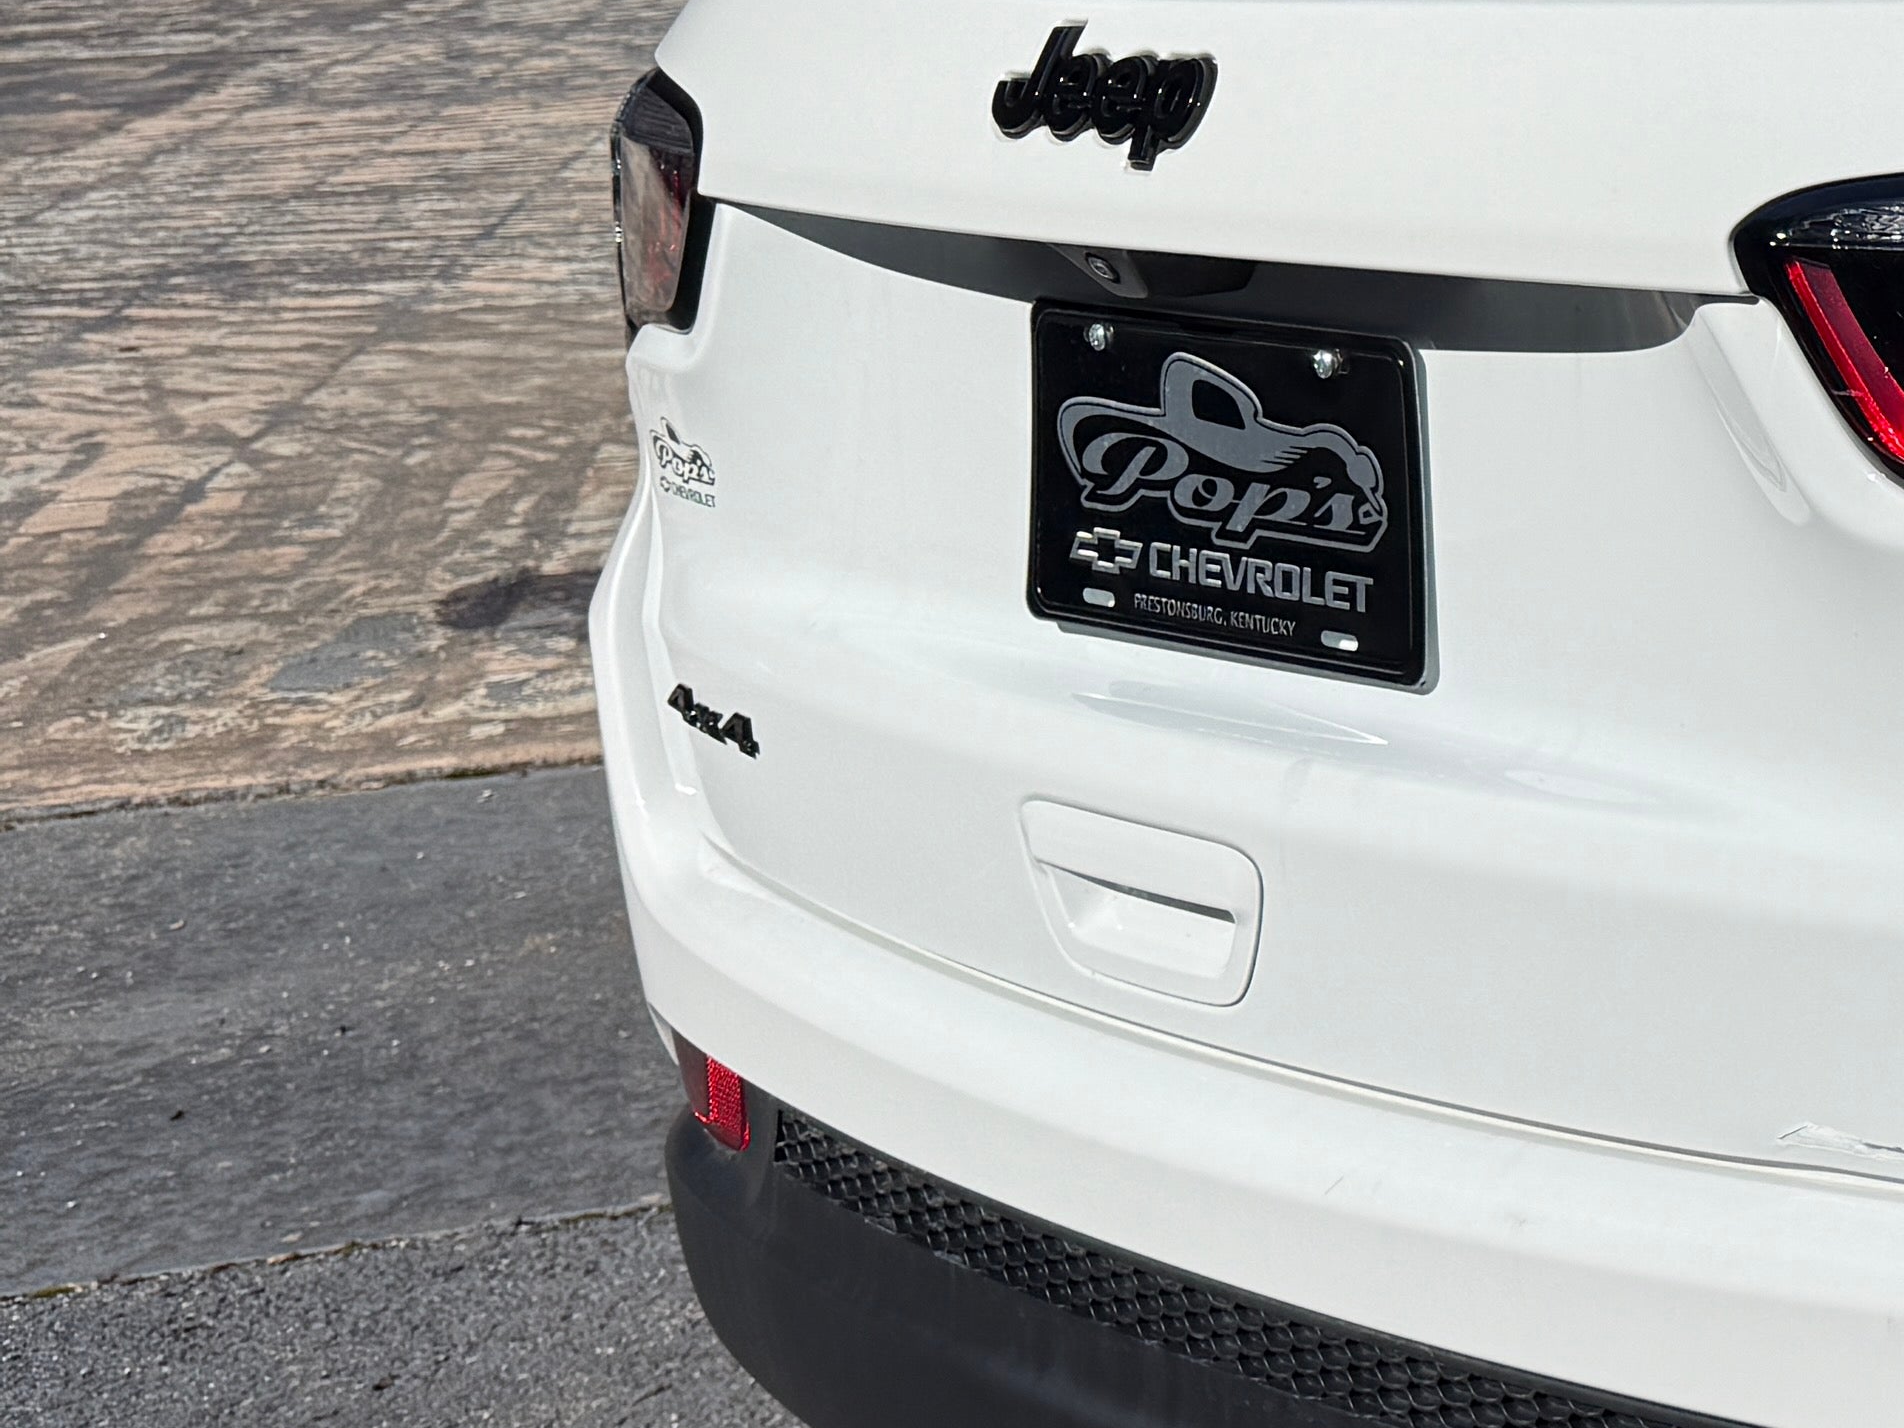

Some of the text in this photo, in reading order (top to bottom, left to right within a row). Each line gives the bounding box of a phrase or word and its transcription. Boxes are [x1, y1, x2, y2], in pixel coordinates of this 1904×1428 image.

[991, 22, 1218, 172] Jeep
[654, 439, 714, 483] Pop's
[1081, 432, 1364, 533] Pop's
[1149, 542, 1374, 613] CHEVROLET
[1134, 592, 1296, 637] PRESTONSBURG, KENTUCKY
